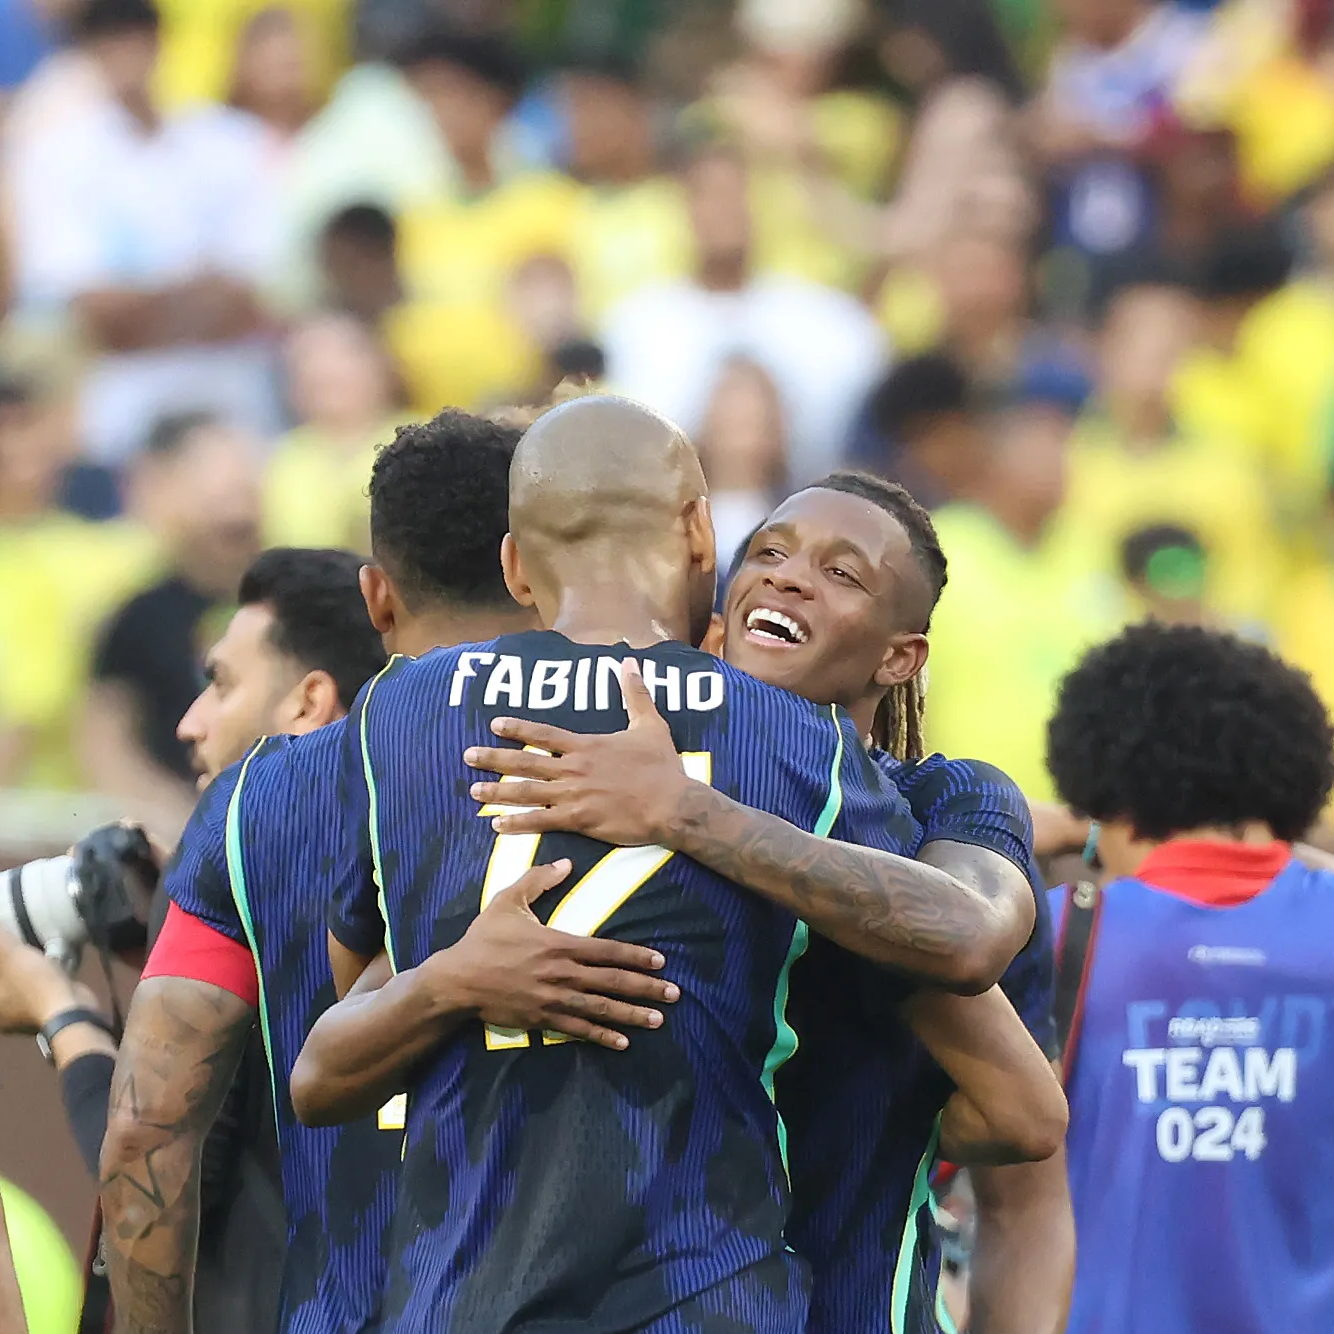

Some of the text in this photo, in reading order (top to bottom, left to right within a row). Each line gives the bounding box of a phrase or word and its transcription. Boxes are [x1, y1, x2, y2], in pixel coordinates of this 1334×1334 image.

[448, 651, 724, 712] FABINHO
[1122, 1047, 1298, 1103] TEAM
[1156, 1107, 1266, 1162] 024
